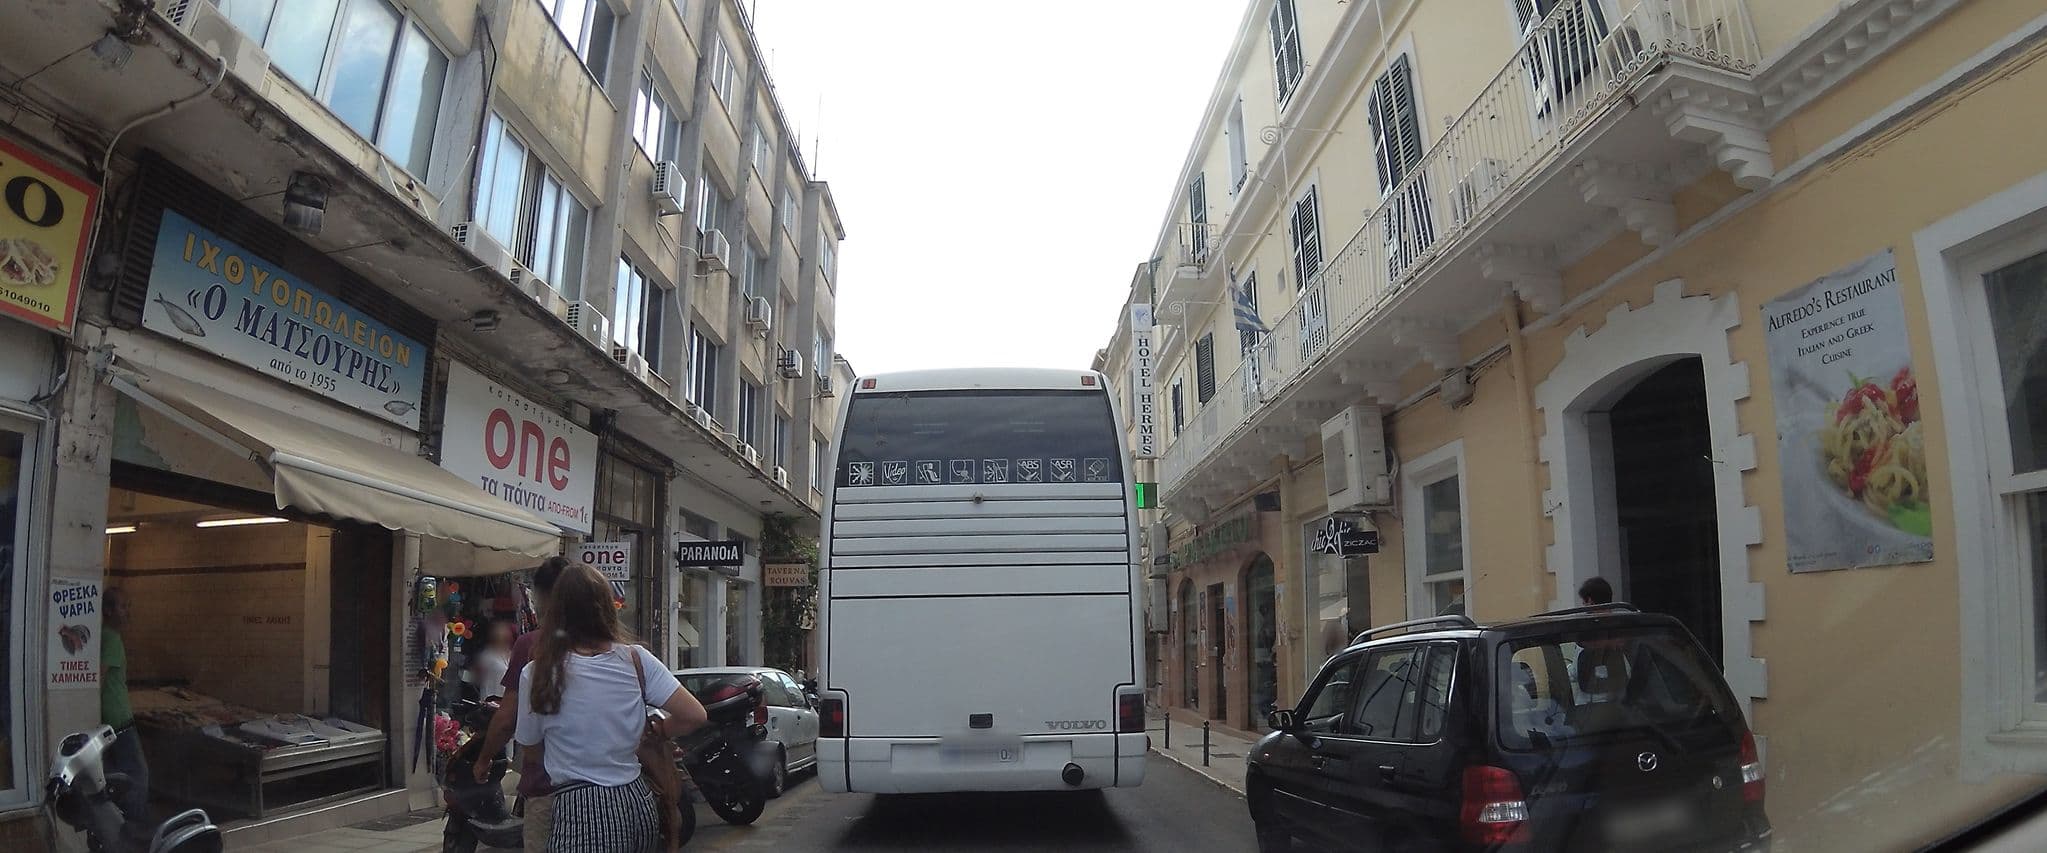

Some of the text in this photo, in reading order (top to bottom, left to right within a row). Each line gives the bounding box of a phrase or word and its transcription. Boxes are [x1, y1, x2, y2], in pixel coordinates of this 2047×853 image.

[183, 232, 411, 368] ΙΧΘΥΟΠΩΛΕΙΟΝ
[1768, 267, 1896, 332] ALFREDO'S RESTAURANT
[1801, 317, 1846, 339] EXPERIENCE
[1797, 340, 1826, 357] ITALIAN
[1846, 323, 1875, 339] GREEK
[1821, 348, 1854, 365] CUISINE
[269, 356, 292, 375] από
[309, 371, 337, 393] 1955
[1138, 338, 1153, 455] HOTEL HERMES
[484, 408, 571, 491] one
[1021, 460, 1040, 470] ABS
[1055, 460, 1073, 469] ASR
[481, 475, 499, 497] τα
[502, 481, 546, 512] πάντα
[582, 550, 625, 565] one
[767, 567, 806, 576] TAVERNA
[53, 584, 98, 604] ΦΡΕΣΚΑ
[59, 601, 95, 619] ΨΑΡΙΑ
[60, 661, 90, 671] ΤΙΜΕΣ
[51, 673, 97, 684] ΧΑΜΗΛΕΣ
[1045, 720, 1107, 730] VOLVO
